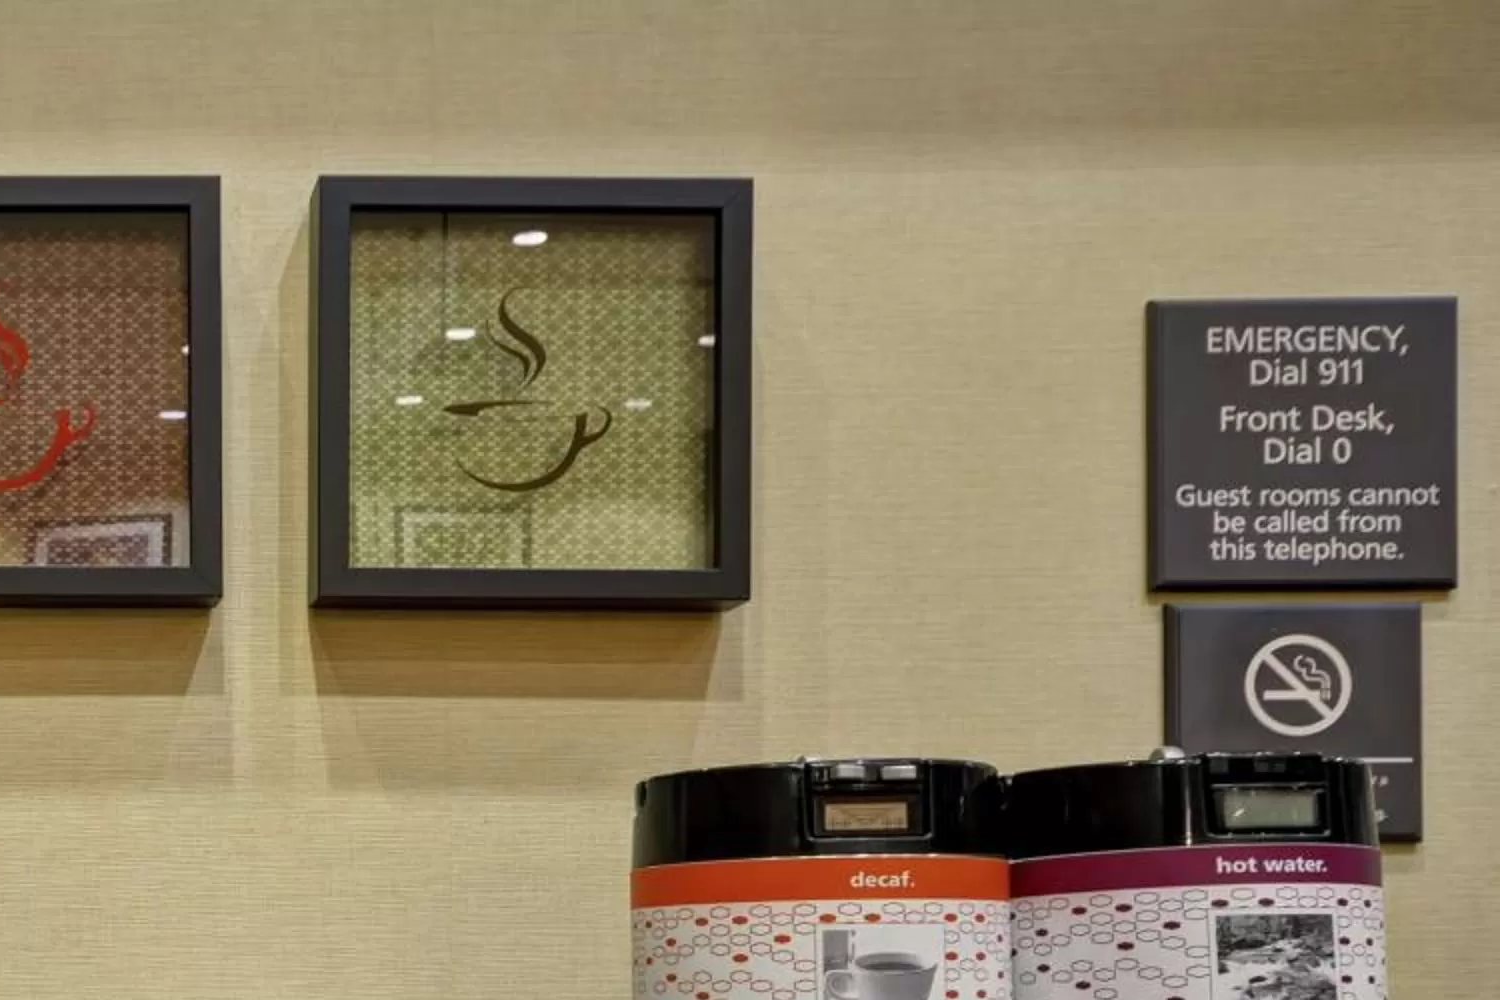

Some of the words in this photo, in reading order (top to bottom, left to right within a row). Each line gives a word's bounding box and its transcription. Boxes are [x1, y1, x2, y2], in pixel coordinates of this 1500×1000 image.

[1206, 324, 1409, 356] EMERGENCY,
[1250, 358, 1308, 385] Dial
[1318, 358, 1365, 385] 911
[1219, 404, 1301, 433] Front
[1311, 403, 1395, 435] Desk,
[1262, 436, 1322, 465] Dial
[1332, 437, 1353, 464] 0
[1175, 484, 1252, 507] Guest
[1259, 487, 1341, 507] rooms
[1348, 484, 1441, 507] cannot
[1213, 510, 1247, 534] be
[1254, 509, 1330, 534] called
[1336, 508, 1402, 533] from
[1209, 536, 1257, 560] this
[1263, 536, 1405, 566] telephone.
[1216, 856, 1259, 873] hot
[1263, 856, 1328, 873] water.
[849, 869, 916, 889] decaf.
